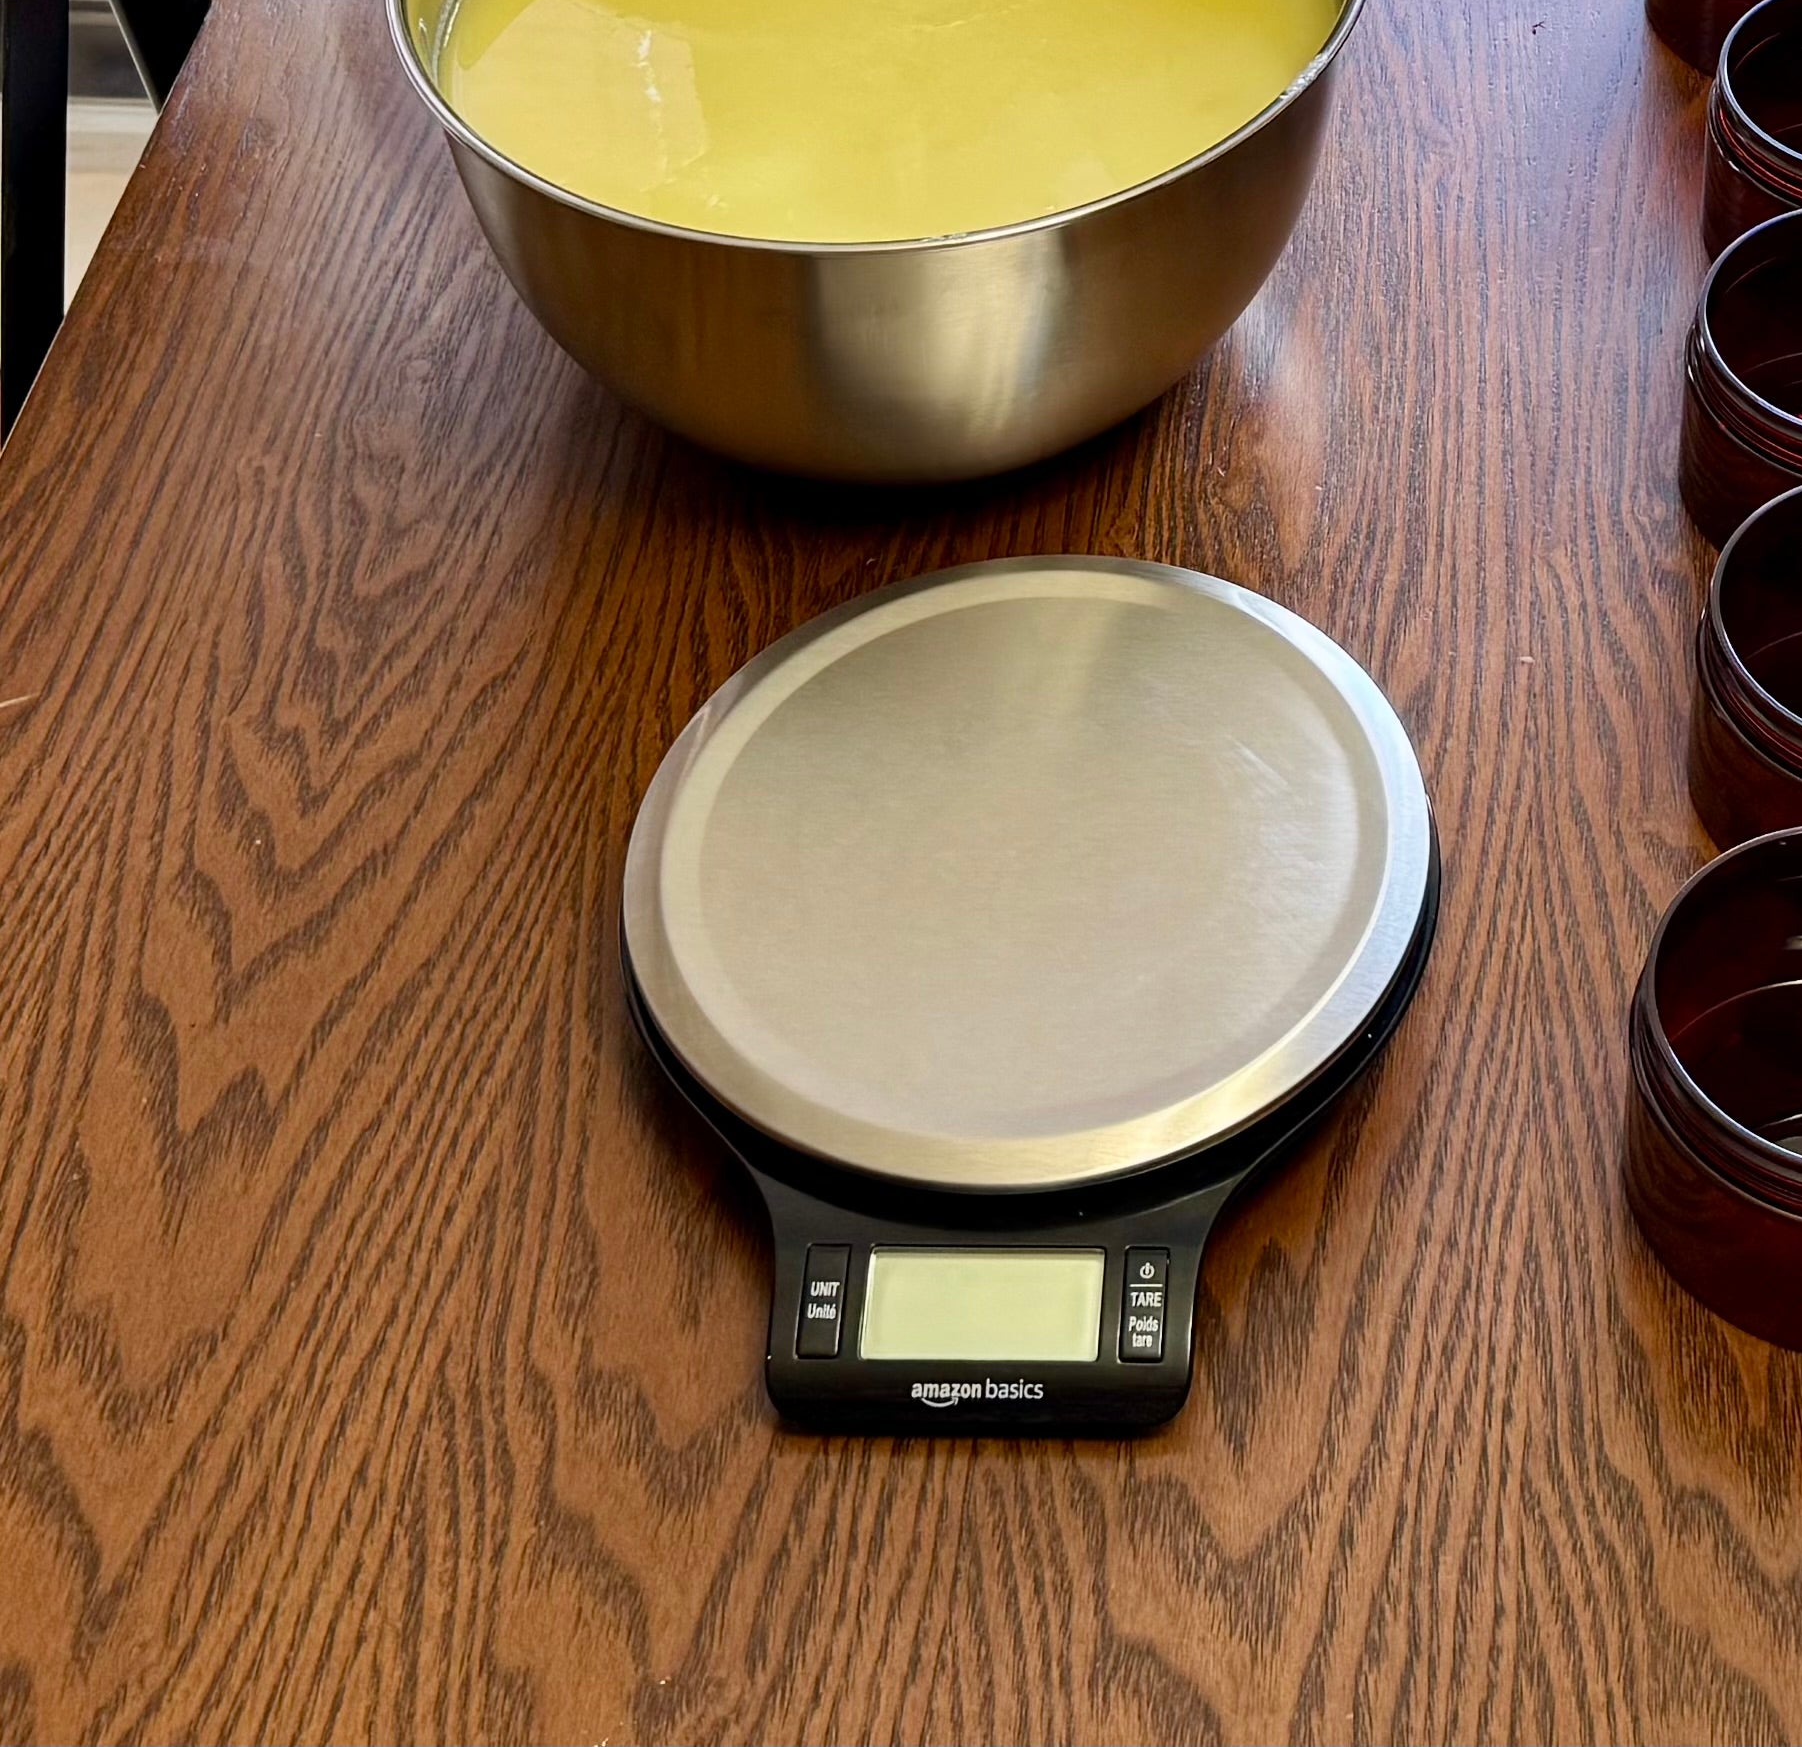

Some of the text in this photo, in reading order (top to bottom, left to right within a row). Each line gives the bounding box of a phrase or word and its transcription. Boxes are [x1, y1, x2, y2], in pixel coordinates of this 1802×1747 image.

[810, 1281, 840, 1297] UNIT
[1130, 1291, 1163, 1307] TARE
[1128, 1315, 1159, 1332] Poids
[1132, 1332, 1153, 1348] tare
[911, 1377, 1044, 1399] amazon basics
